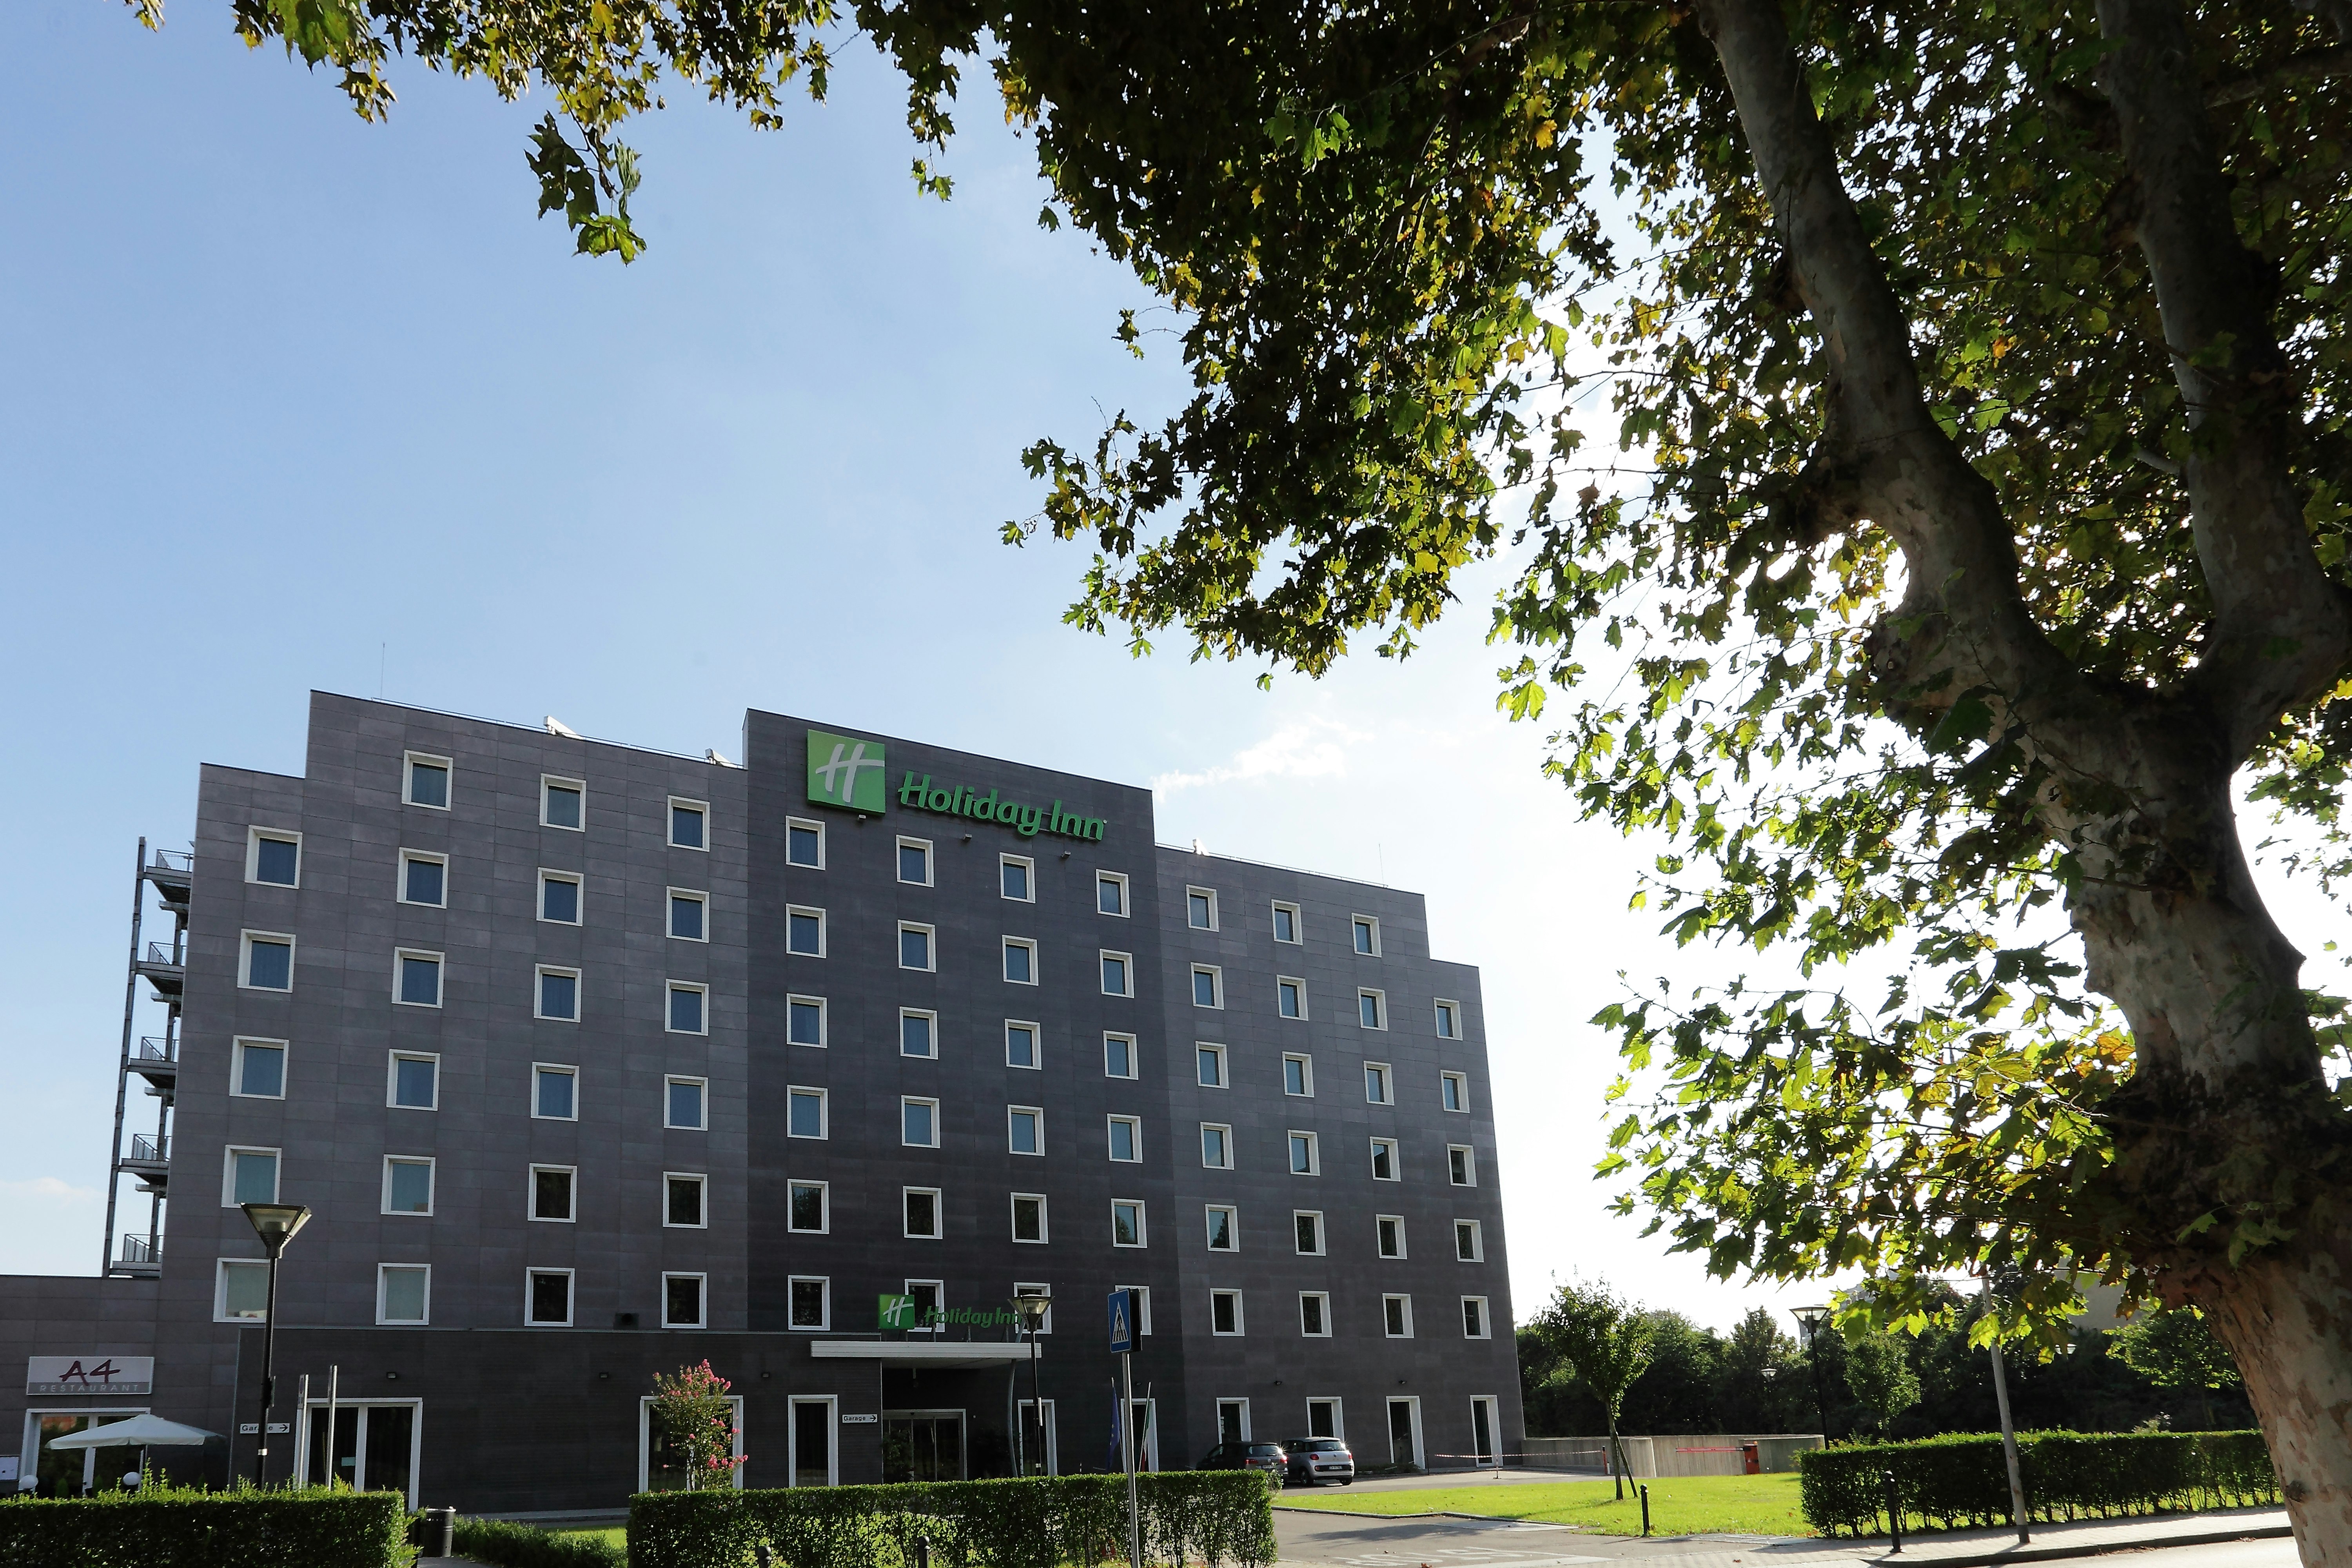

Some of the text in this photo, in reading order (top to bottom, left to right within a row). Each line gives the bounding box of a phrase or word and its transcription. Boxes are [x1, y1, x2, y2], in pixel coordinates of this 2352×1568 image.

[816, 743, 885, 802] H
[898, 770, 1103, 840] Holiday Inn
[883, 1297, 913, 1326] H
[924, 1305, 1022, 1328] Holiday Inn
[59, 1359, 121, 1386] A4
